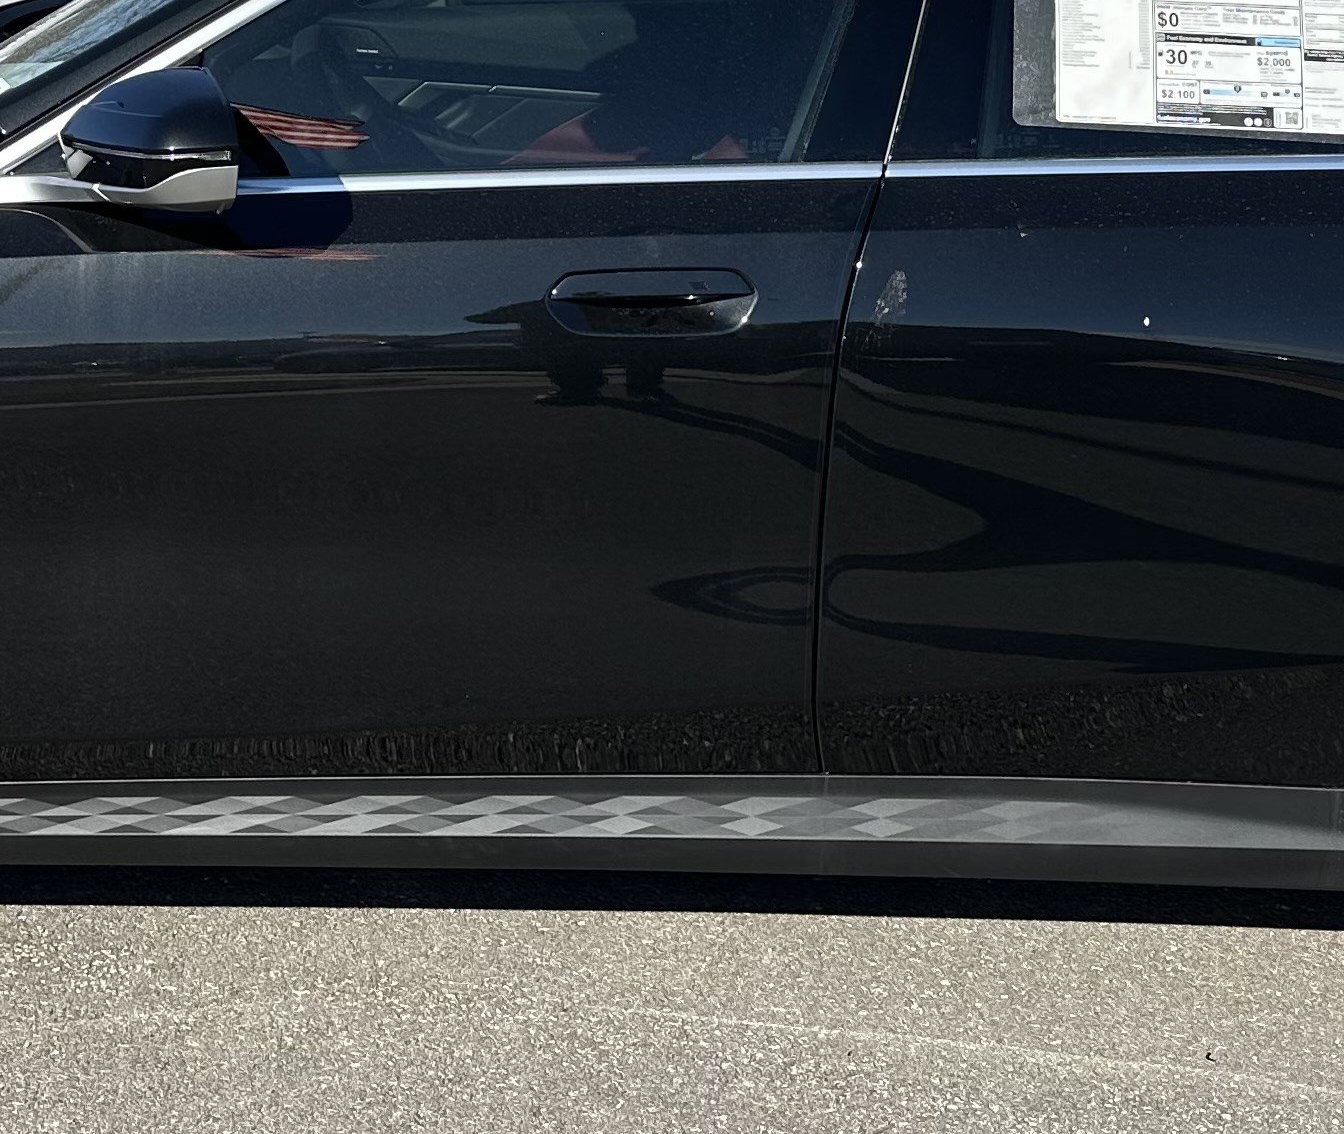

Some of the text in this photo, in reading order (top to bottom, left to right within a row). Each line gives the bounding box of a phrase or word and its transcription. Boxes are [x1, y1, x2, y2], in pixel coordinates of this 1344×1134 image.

[1157, 11, 1179, 28] $0
[1166, 49, 1188, 65] 30
[1161, 89, 1196, 99] $2100
